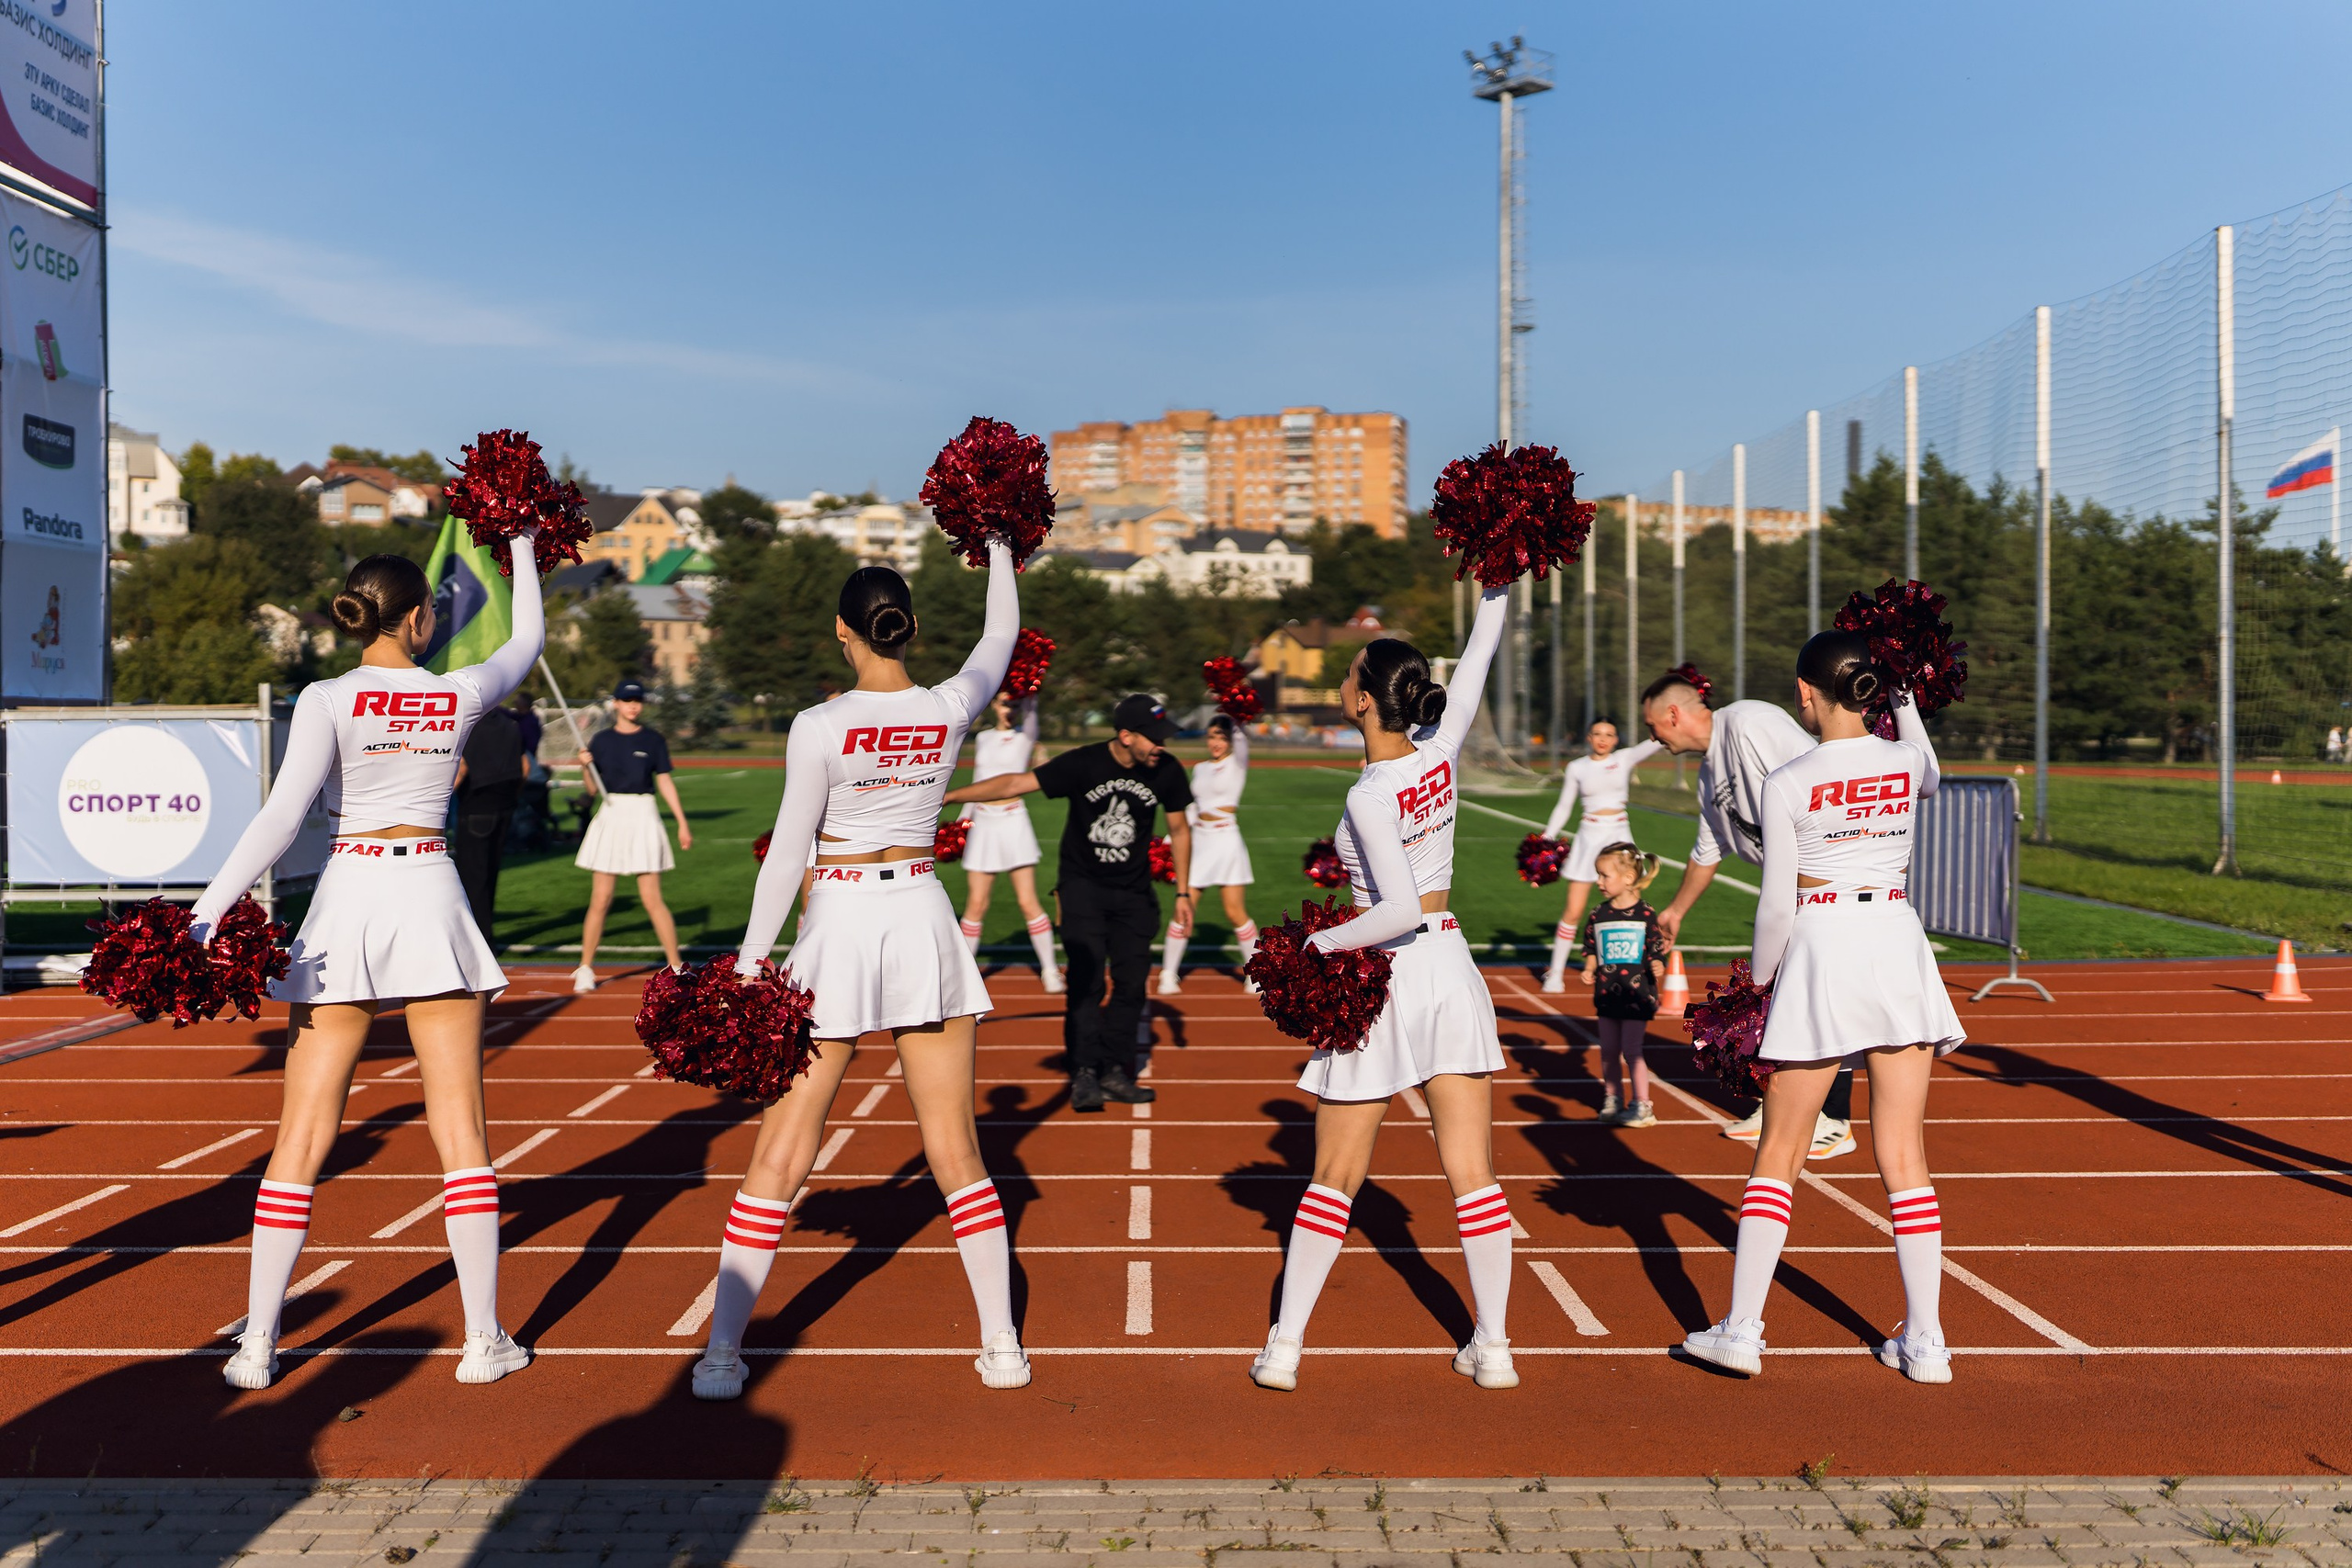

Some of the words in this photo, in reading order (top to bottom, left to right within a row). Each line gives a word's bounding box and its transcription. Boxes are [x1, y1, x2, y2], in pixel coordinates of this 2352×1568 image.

[38, 19, 93, 70] ХОЛДИНГ
[25, 62, 40, 85] ЭТУ
[40, 73, 61, 97] АРКУ
[61, 84, 90, 115] СДЕЛАЛ
[30, 93, 55, 121] БАЗИС
[56, 107, 91, 140] ХОЛДИНГ
[33, 243, 80, 283] СБЕР
[22, 506, 84, 539] Pandora
[352, 691, 458, 717] RED
[387, 719, 456, 732] STAR
[362, 740, 411, 753] ACTION
[842, 724, 948, 755] RED
[876, 751, 942, 768] STAR
[67, 779, 101, 791] PRO
[853, 775, 899, 789] ACTION
[901, 777, 936, 788] TEAM
[1396, 760, 1452, 820] RED
[1808, 772, 1910, 812] RED
[68, 794, 161, 813] СПОРТ
[167, 794, 201, 813] 40
[1414, 788, 1453, 826] STAR
[1846, 801, 1910, 820] STAR
[1823, 827, 1869, 840] ACTION
[1872, 829, 1907, 840] TEAM
[329, 842, 385, 857] STAR
[1606, 942, 1639, 960] 3524
